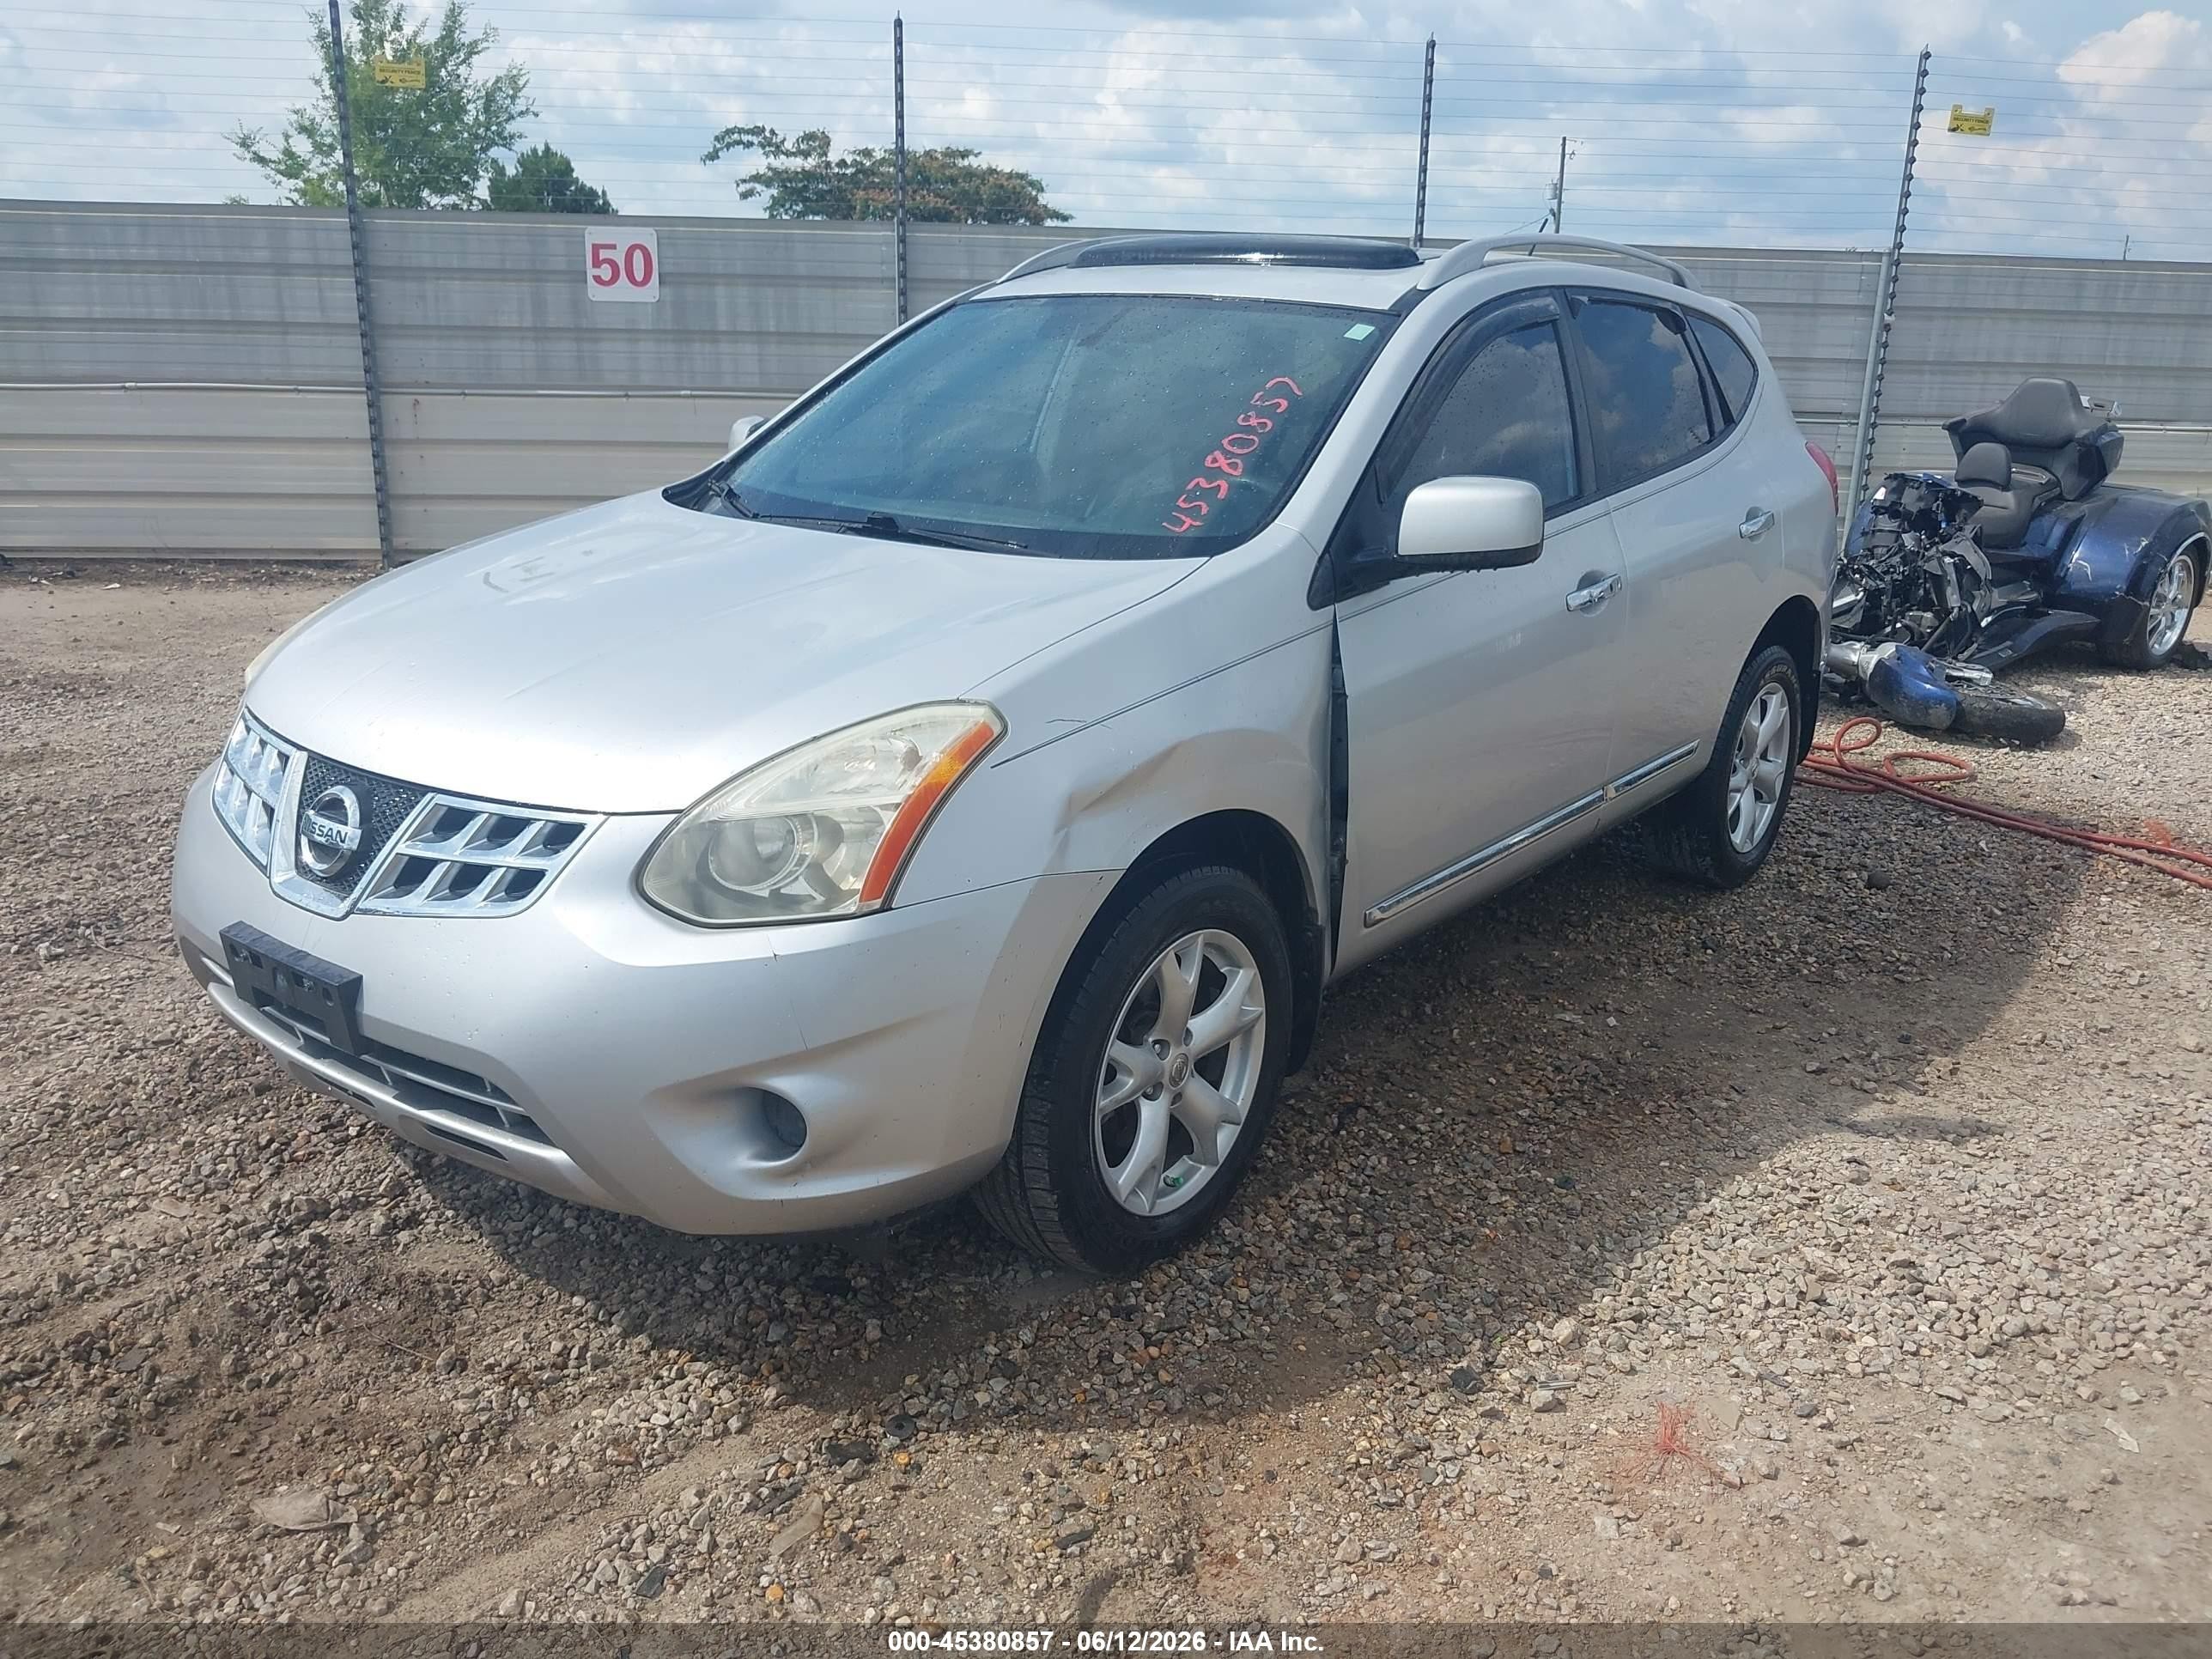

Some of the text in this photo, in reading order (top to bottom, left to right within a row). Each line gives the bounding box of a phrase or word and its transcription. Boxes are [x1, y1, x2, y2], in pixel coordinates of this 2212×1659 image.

[592, 243, 653, 288] 50
[1162, 377, 1304, 532] 45380857
[302, 812, 349, 844] SSAN
